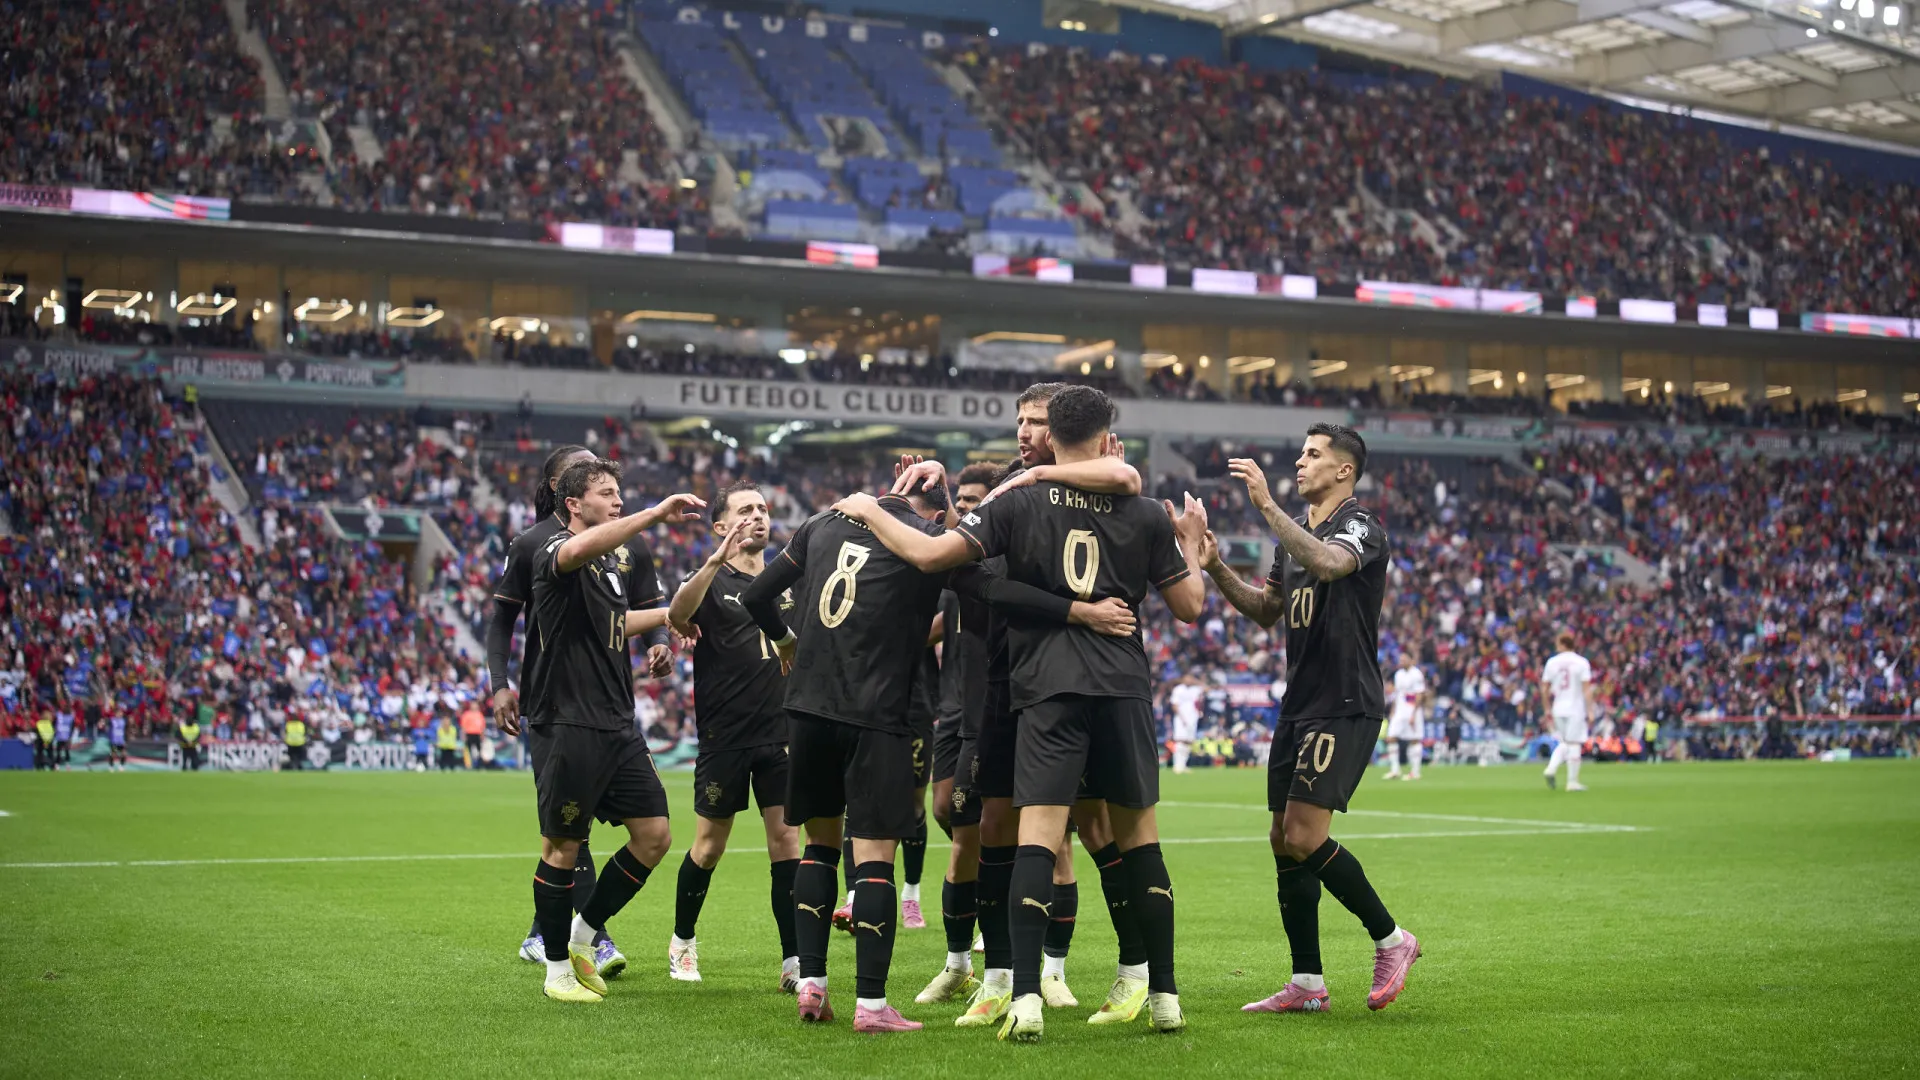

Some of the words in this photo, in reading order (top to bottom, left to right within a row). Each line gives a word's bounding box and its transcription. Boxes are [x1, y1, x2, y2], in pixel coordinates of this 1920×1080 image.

[680, 382, 829, 411] FUTEBOL
[844, 390, 948, 416] CLUBE
[963, 396, 1004, 418] DO
[818, 540, 873, 629] 8
[1062, 528, 1100, 601] 9
[1290, 586, 1314, 629] 20
[608, 610, 625, 652] 15
[1296, 731, 1335, 774] 20
